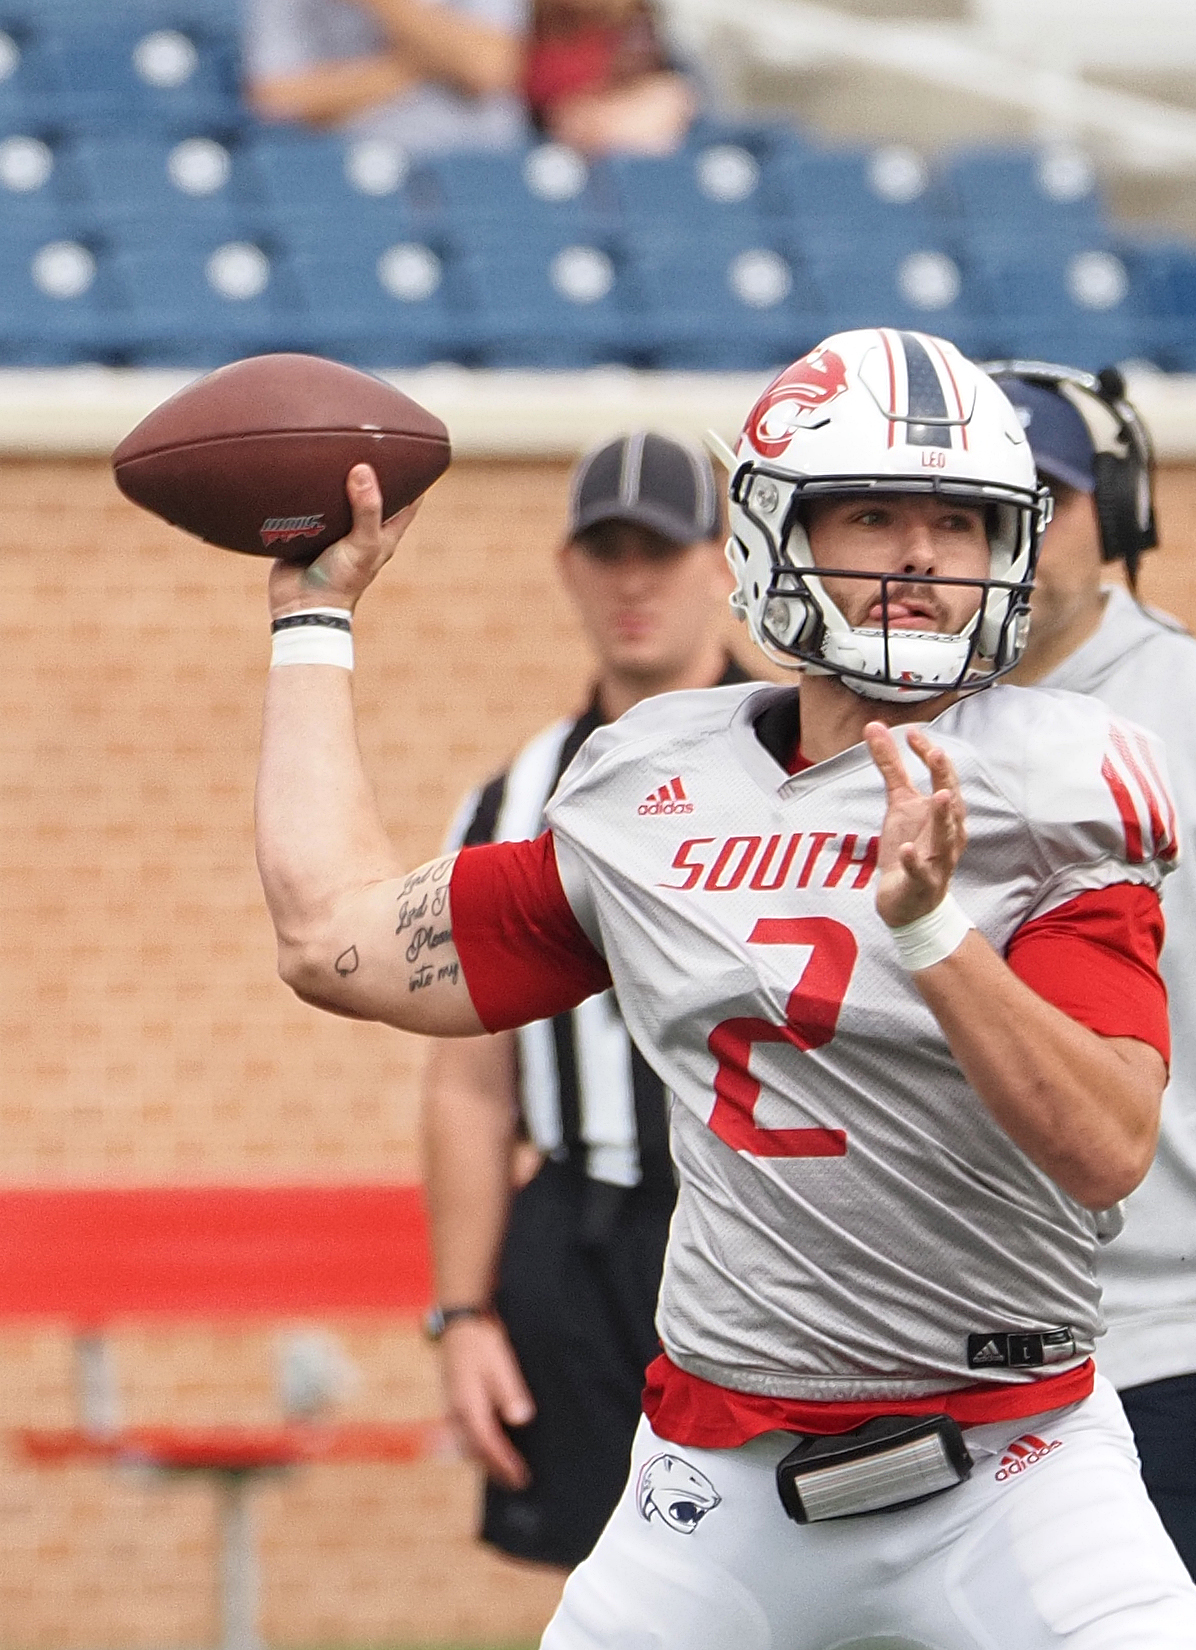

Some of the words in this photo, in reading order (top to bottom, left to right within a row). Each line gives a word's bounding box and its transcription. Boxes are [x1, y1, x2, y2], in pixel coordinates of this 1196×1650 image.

[921, 451, 946, 469] LEO
[637, 801, 694, 816] adidas
[654, 831, 881, 892] SOUTH
[707, 916, 859, 1158] 2
[995, 1439, 1063, 1482] adidas
